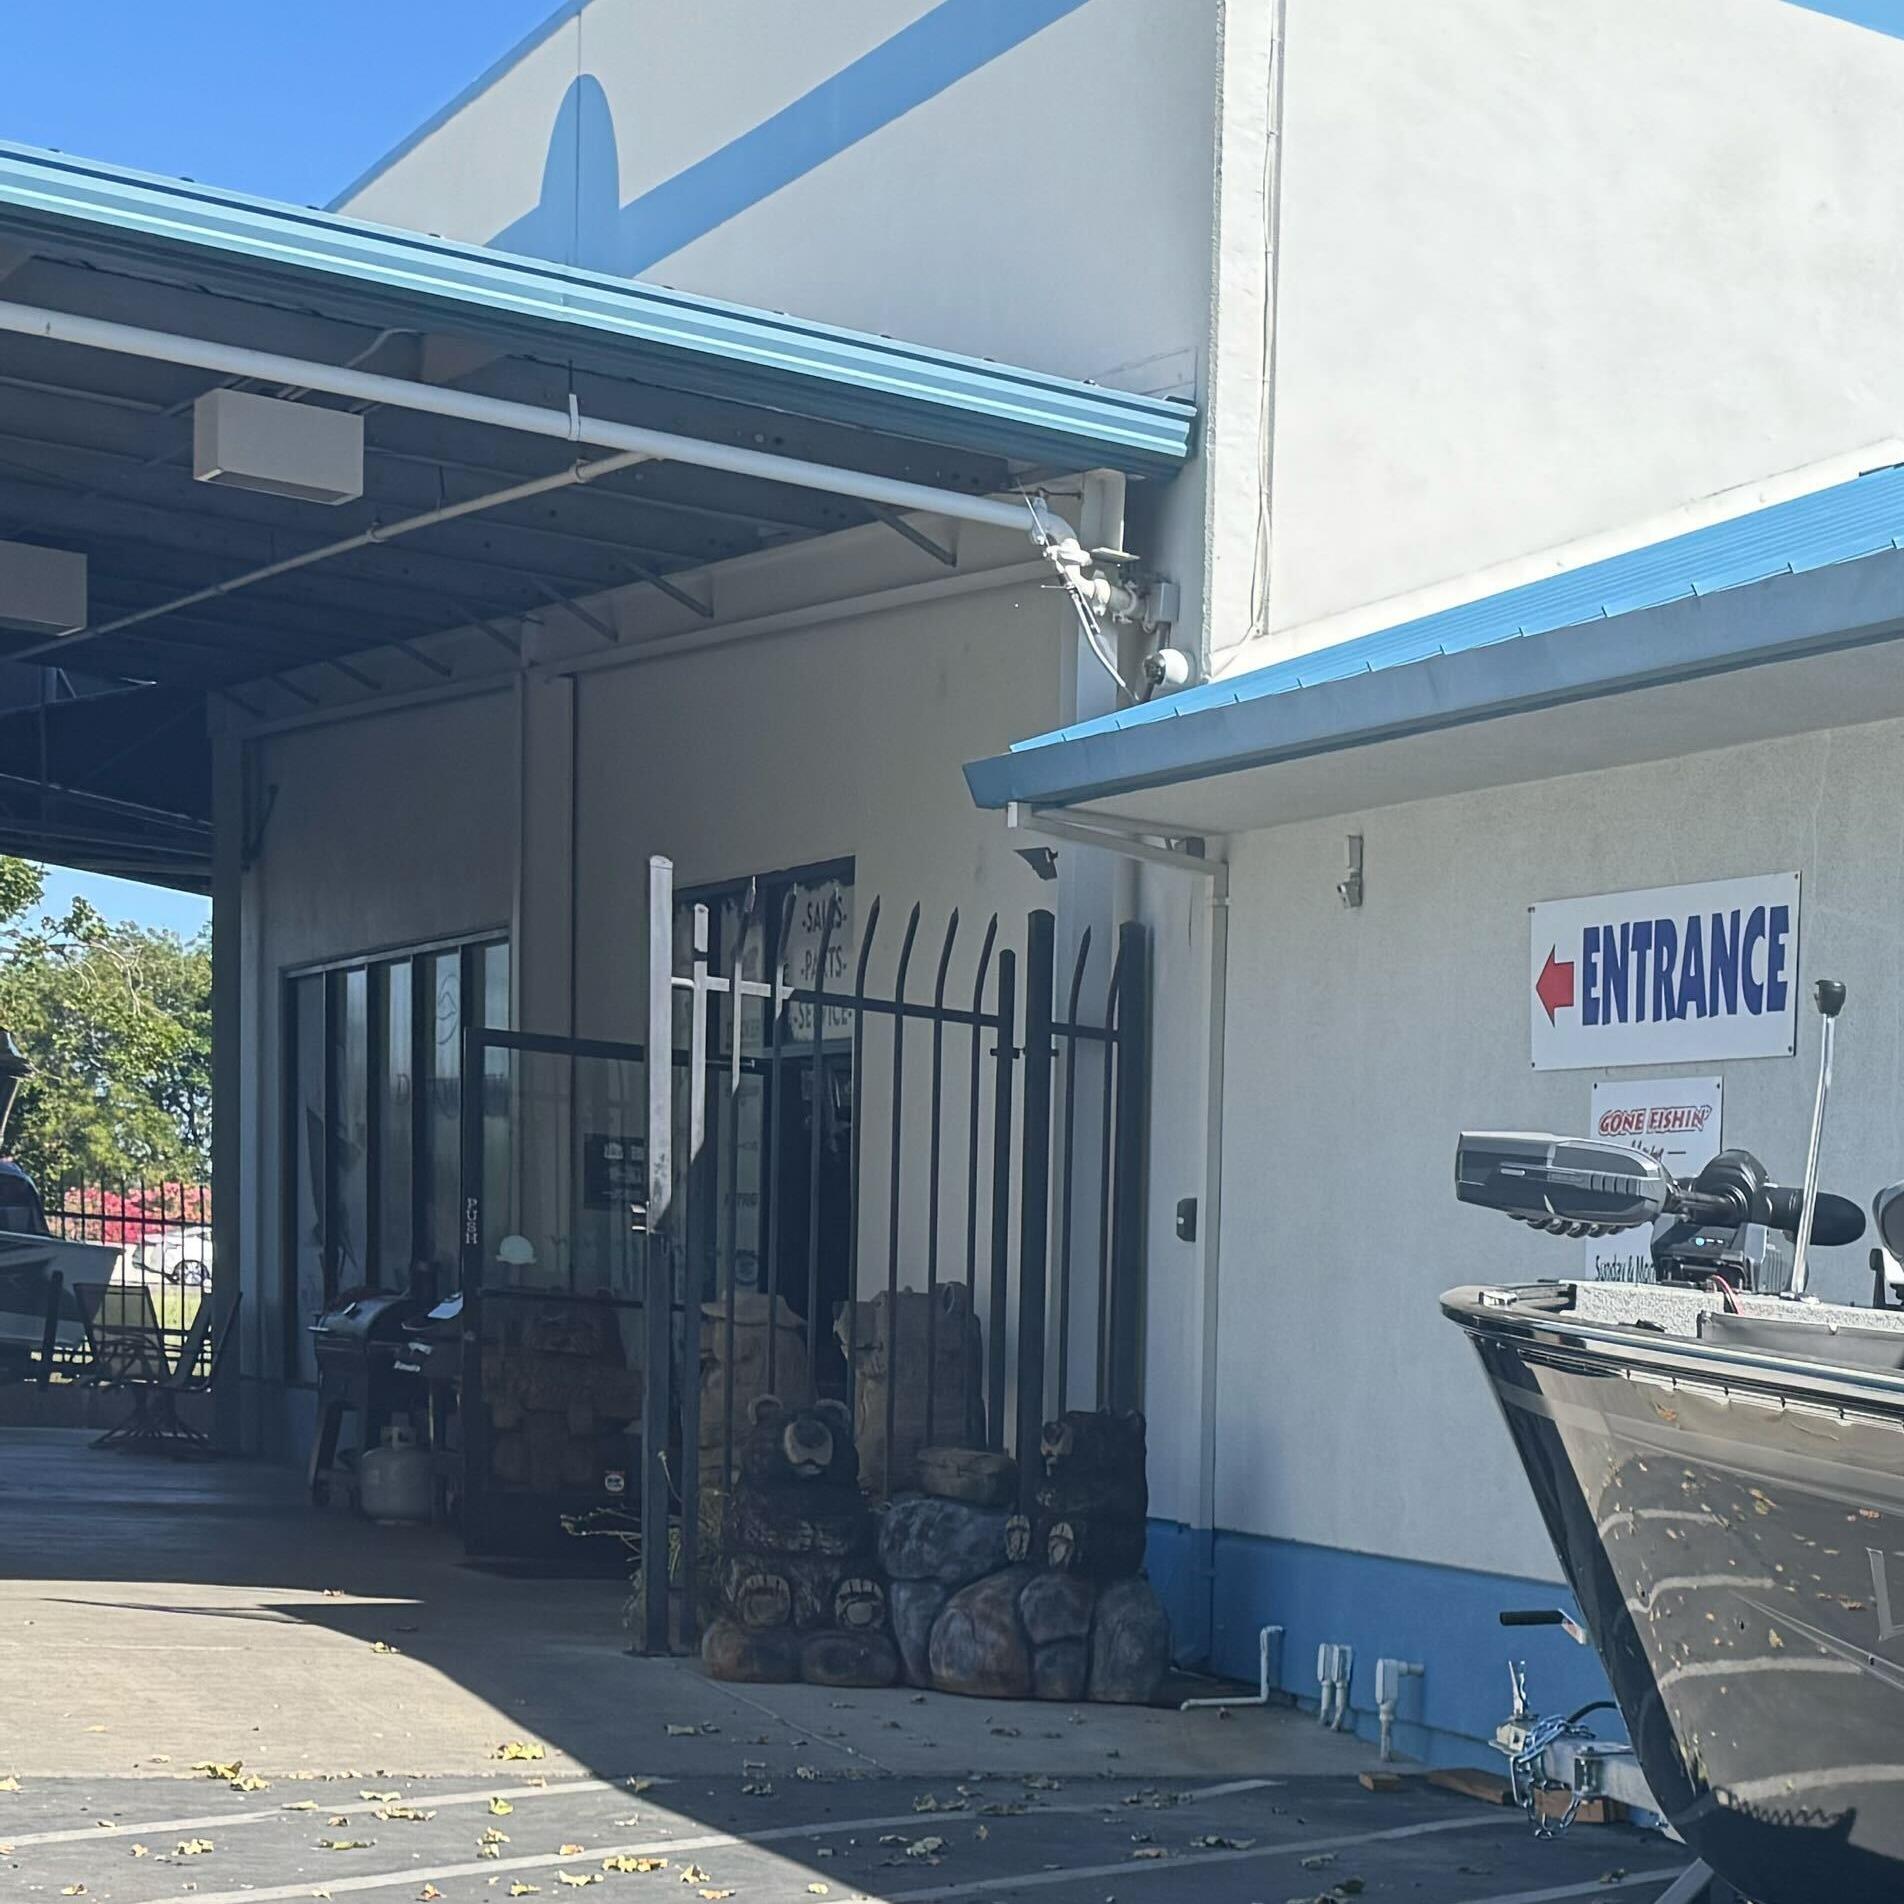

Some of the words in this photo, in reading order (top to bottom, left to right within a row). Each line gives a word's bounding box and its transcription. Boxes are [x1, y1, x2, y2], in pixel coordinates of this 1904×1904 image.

[1582, 905, 1789, 1026] ENTRANCE
[1599, 1108, 1647, 1136] GONE
[466, 1197, 478, 1245] PUSH
